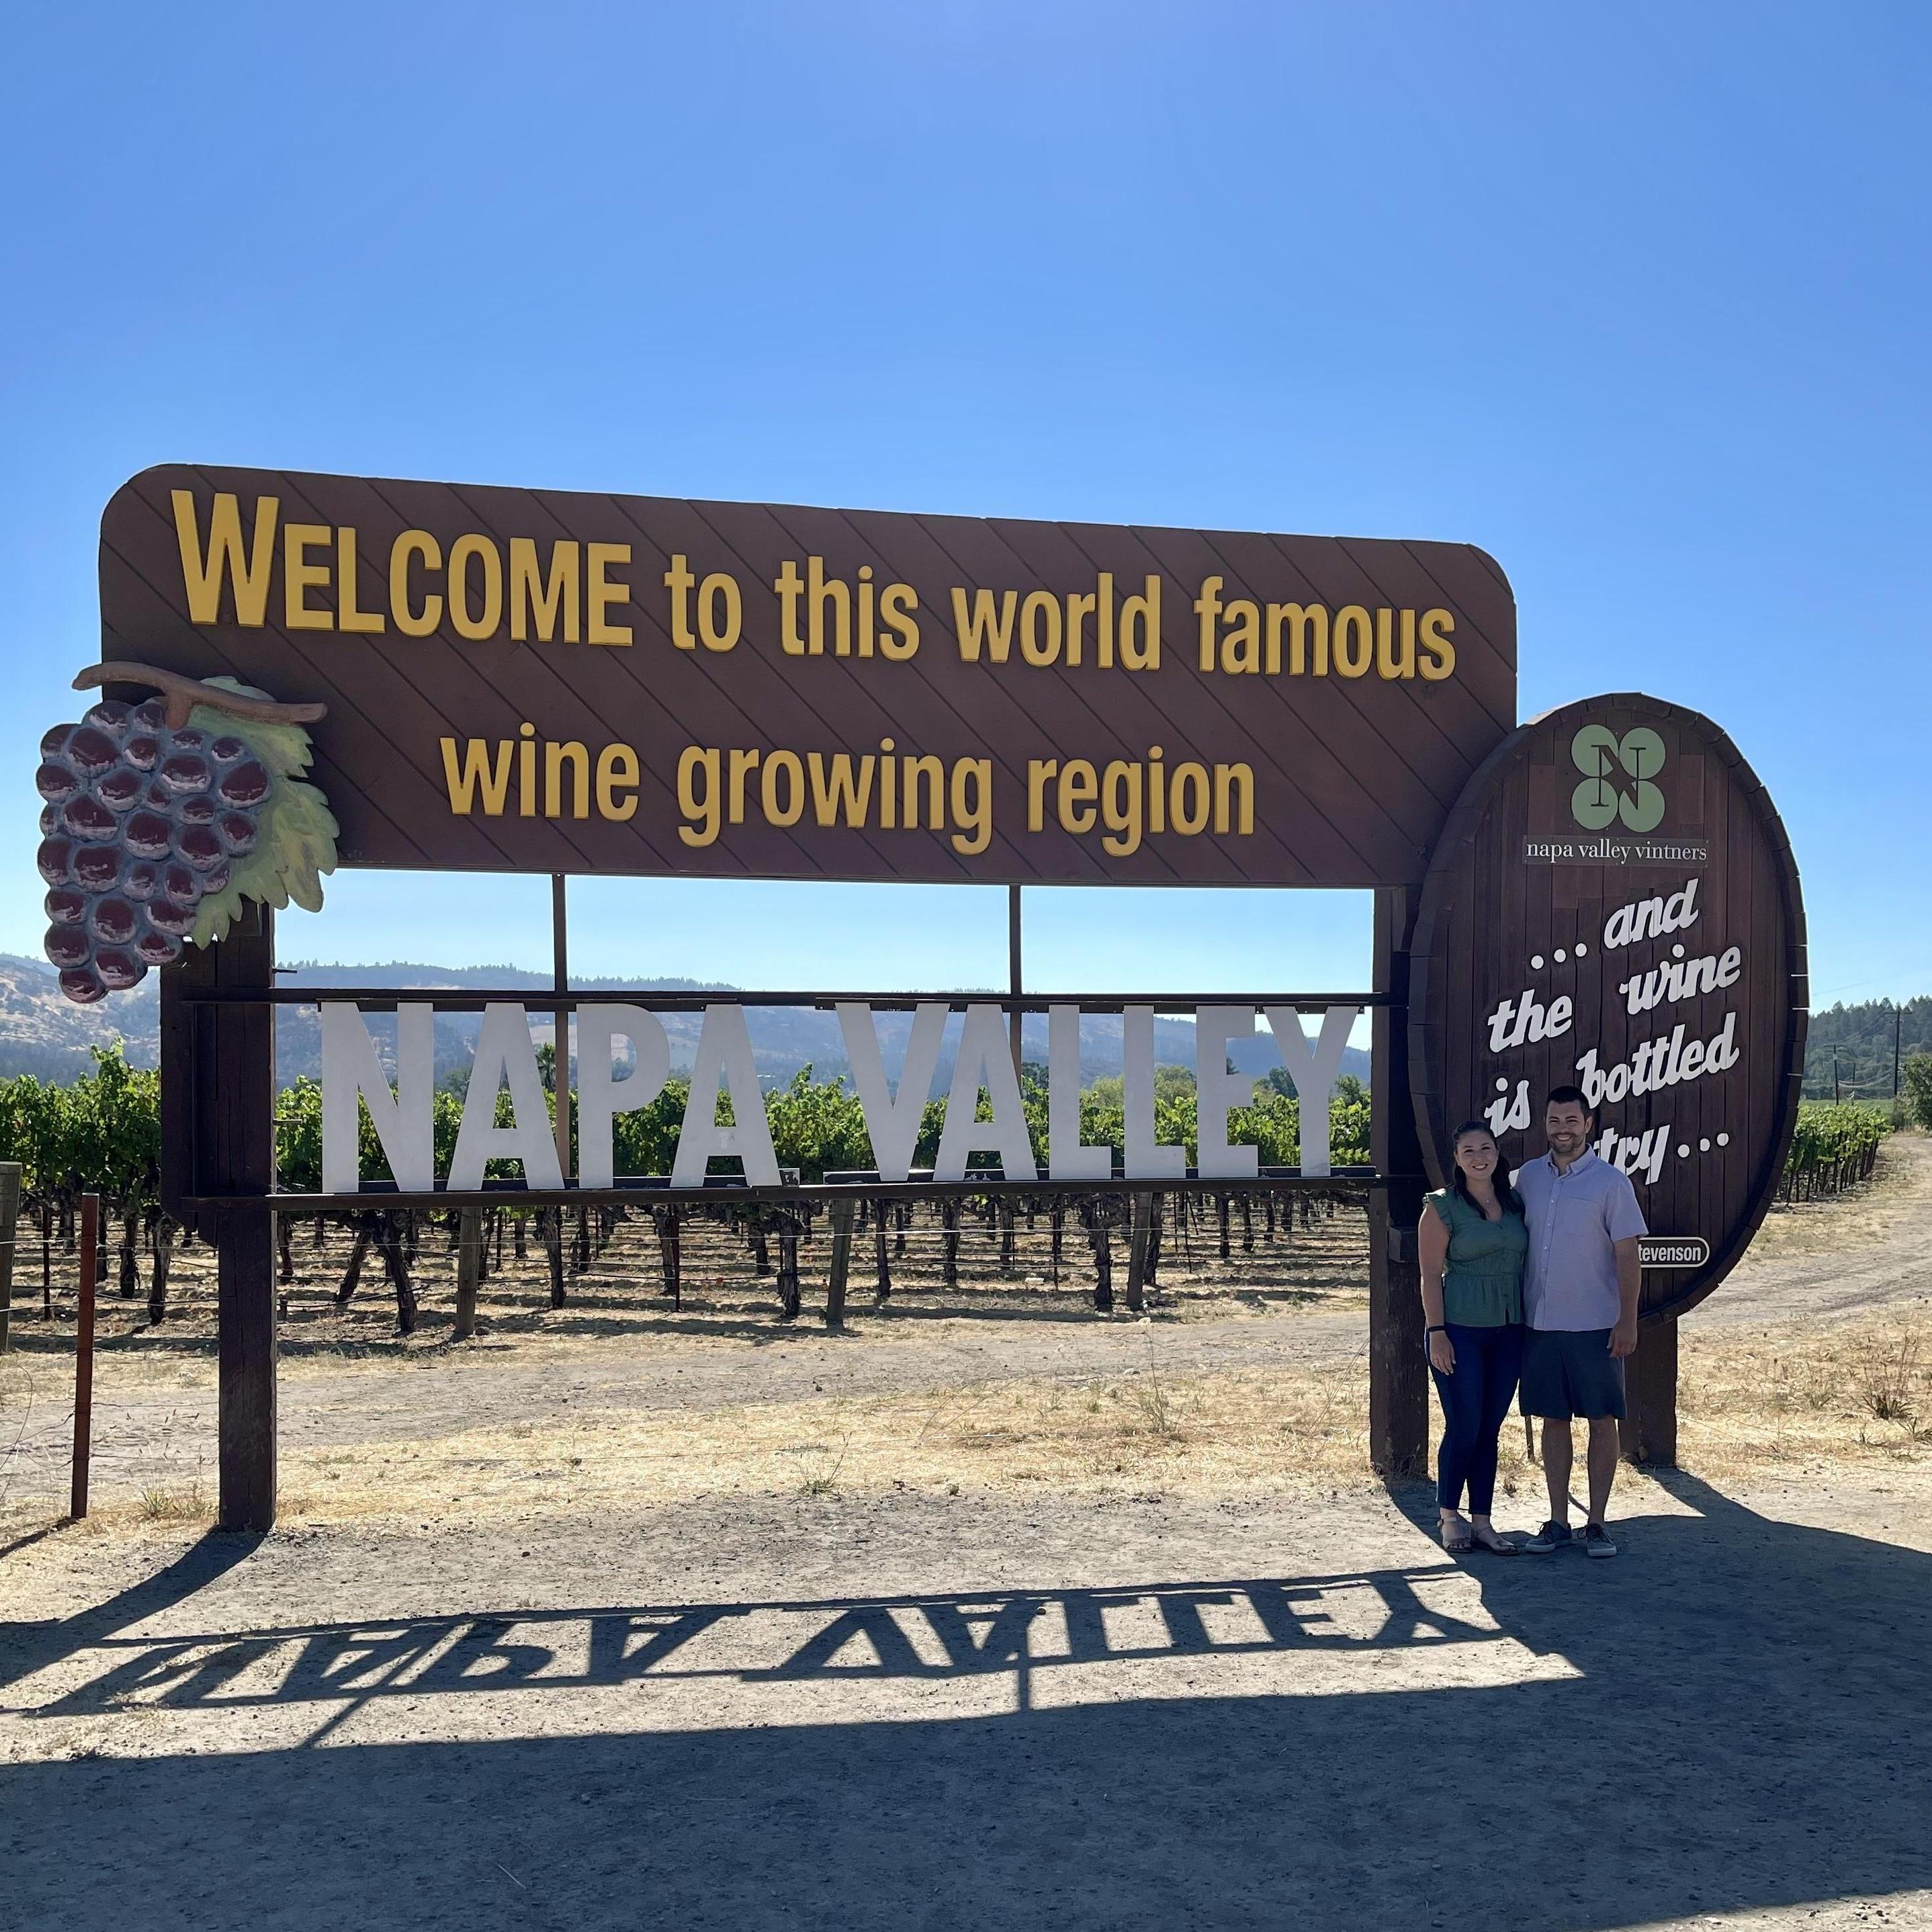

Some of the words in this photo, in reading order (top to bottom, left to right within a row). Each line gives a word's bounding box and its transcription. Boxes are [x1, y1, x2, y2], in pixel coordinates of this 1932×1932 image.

[171, 490, 633, 646] WELCOME
[663, 554, 742, 652] to
[774, 556, 920, 662] this
[951, 572, 1161, 671] world
[1193, 576, 1456, 681] famous
[439, 722, 640, 821] wine
[676, 738, 992, 856] growing
[1028, 746, 1254, 857] region
[1526, 844, 1574, 864] napa
[1578, 838, 1631, 865] valley
[1634, 840, 1708, 861] vintners
[1604, 879, 1698, 949] and
[1487, 989, 1573, 1053] the
[1620, 945, 1741, 1015] wine
[321, 1001, 783, 1194] NAPA
[835, 1002, 1357, 1182] VALLEY
[1483, 1077, 1530, 1138] is
[1575, 1012, 1740, 1109] bottled
[1638, 1243, 1702, 1262] tevenson
